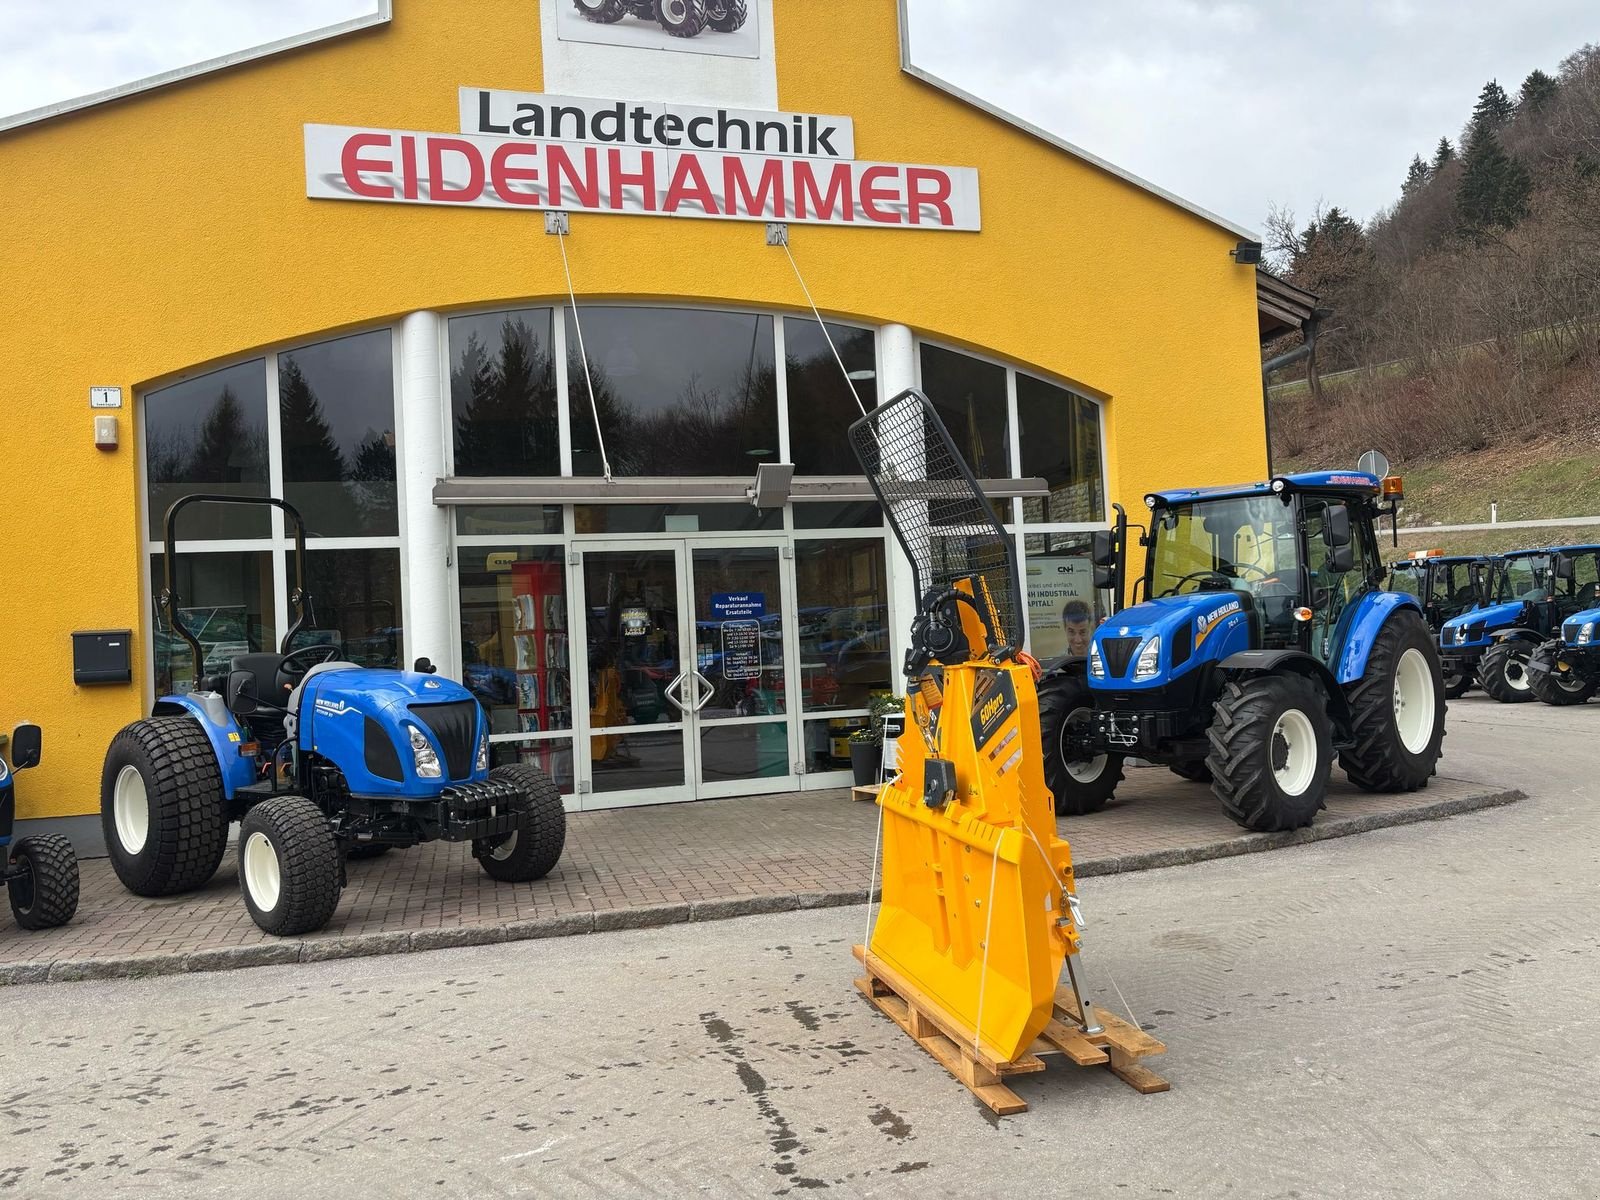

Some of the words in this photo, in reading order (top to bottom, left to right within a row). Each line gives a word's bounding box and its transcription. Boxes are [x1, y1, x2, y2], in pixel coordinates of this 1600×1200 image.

[478, 91, 840, 157] Landtechnik
[340, 132, 955, 227] EIDENHAMMER
[104, 392, 108, 402] 1
[1207, 610, 1218, 623] NEW
[1218, 601, 1239, 616] HOLLAND
[980, 693, 1004, 725] 60Hpro
